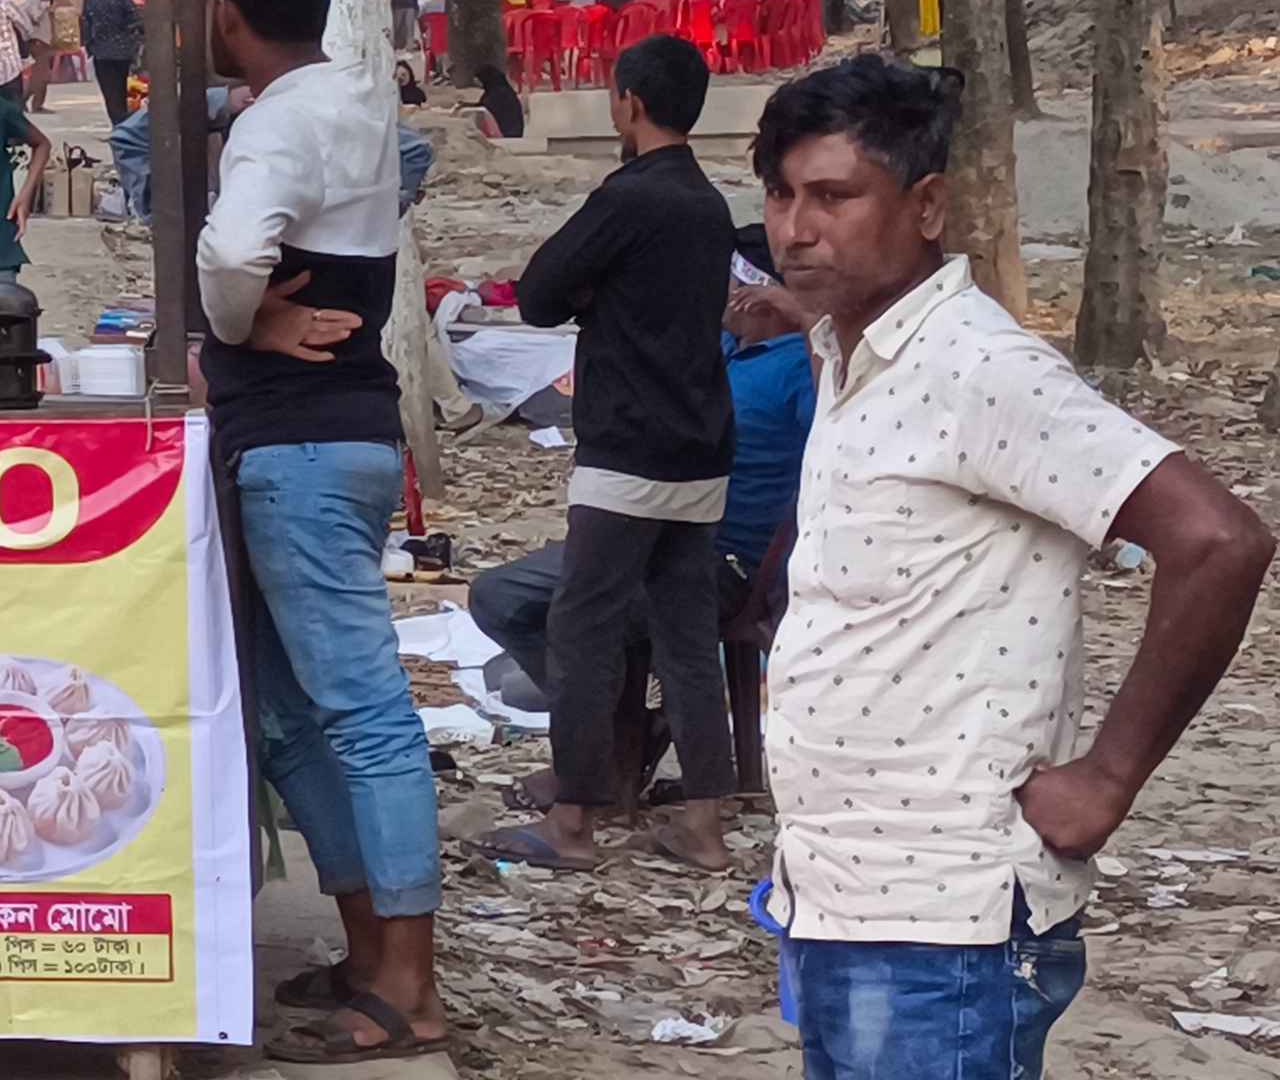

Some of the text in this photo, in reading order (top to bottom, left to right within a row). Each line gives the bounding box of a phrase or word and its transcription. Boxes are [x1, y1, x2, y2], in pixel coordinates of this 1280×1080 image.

[47, 901, 132, 932] মোমো
[4, 935, 36, 953] পিস
[62, 940, 86, 954] ৬০
[7, 954, 38, 973] পিস
